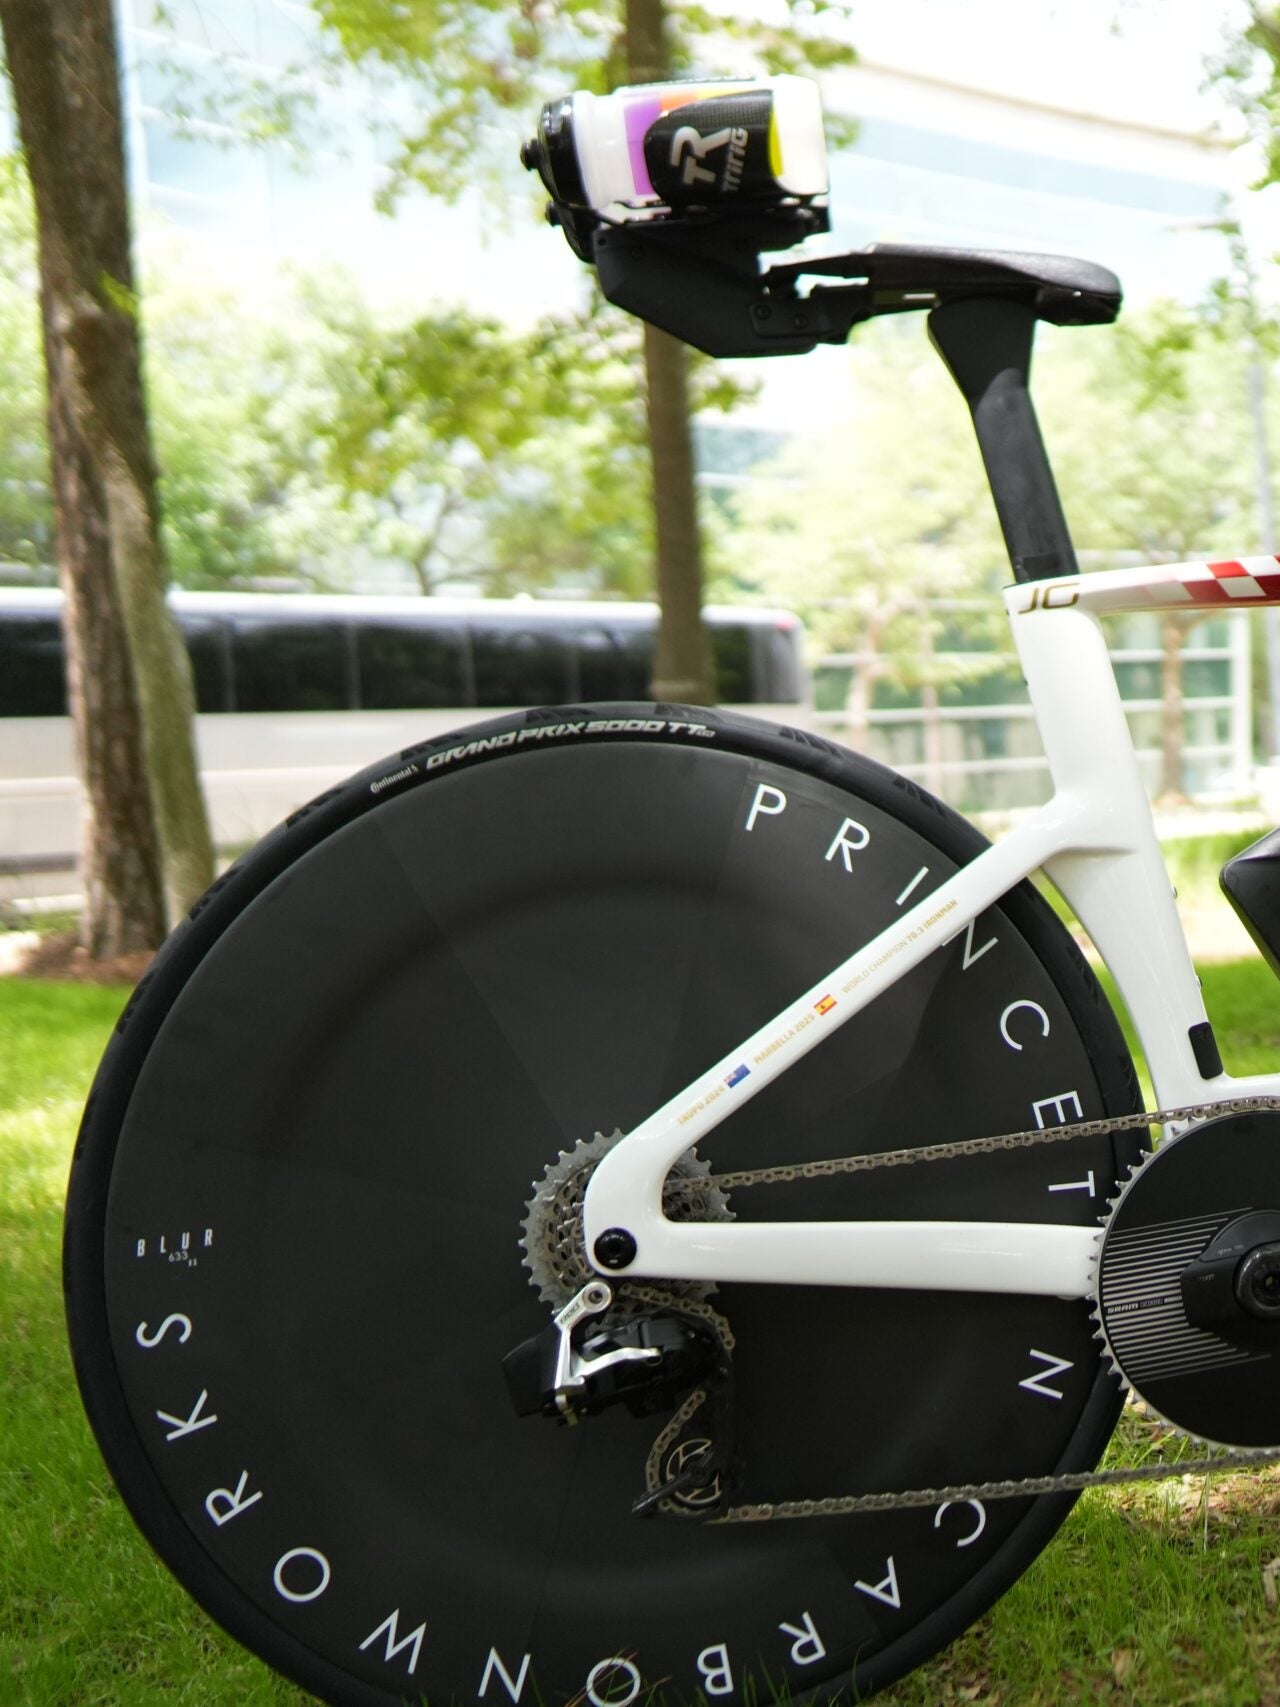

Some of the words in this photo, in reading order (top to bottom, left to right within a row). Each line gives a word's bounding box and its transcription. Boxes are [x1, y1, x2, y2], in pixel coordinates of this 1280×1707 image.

[426, 732, 515, 771] GRAND
[516, 721, 585, 745] PRIX
[584, 719, 669, 735] 5000
[753, 1029, 796, 1065] MARBELLA
[841, 967, 871, 994] WORLD
[868, 938, 907, 972] CHAMPION
[907, 926, 925, 943] 70.3
[923, 899, 959, 929] IRONMAN
[745, 784, 1097, 1398] PRINCETN
[136, 1228, 213, 1257] BLUR
[136, 1313, 427, 1675] WORKS
[478, 1498, 986, 1707] CARBON
